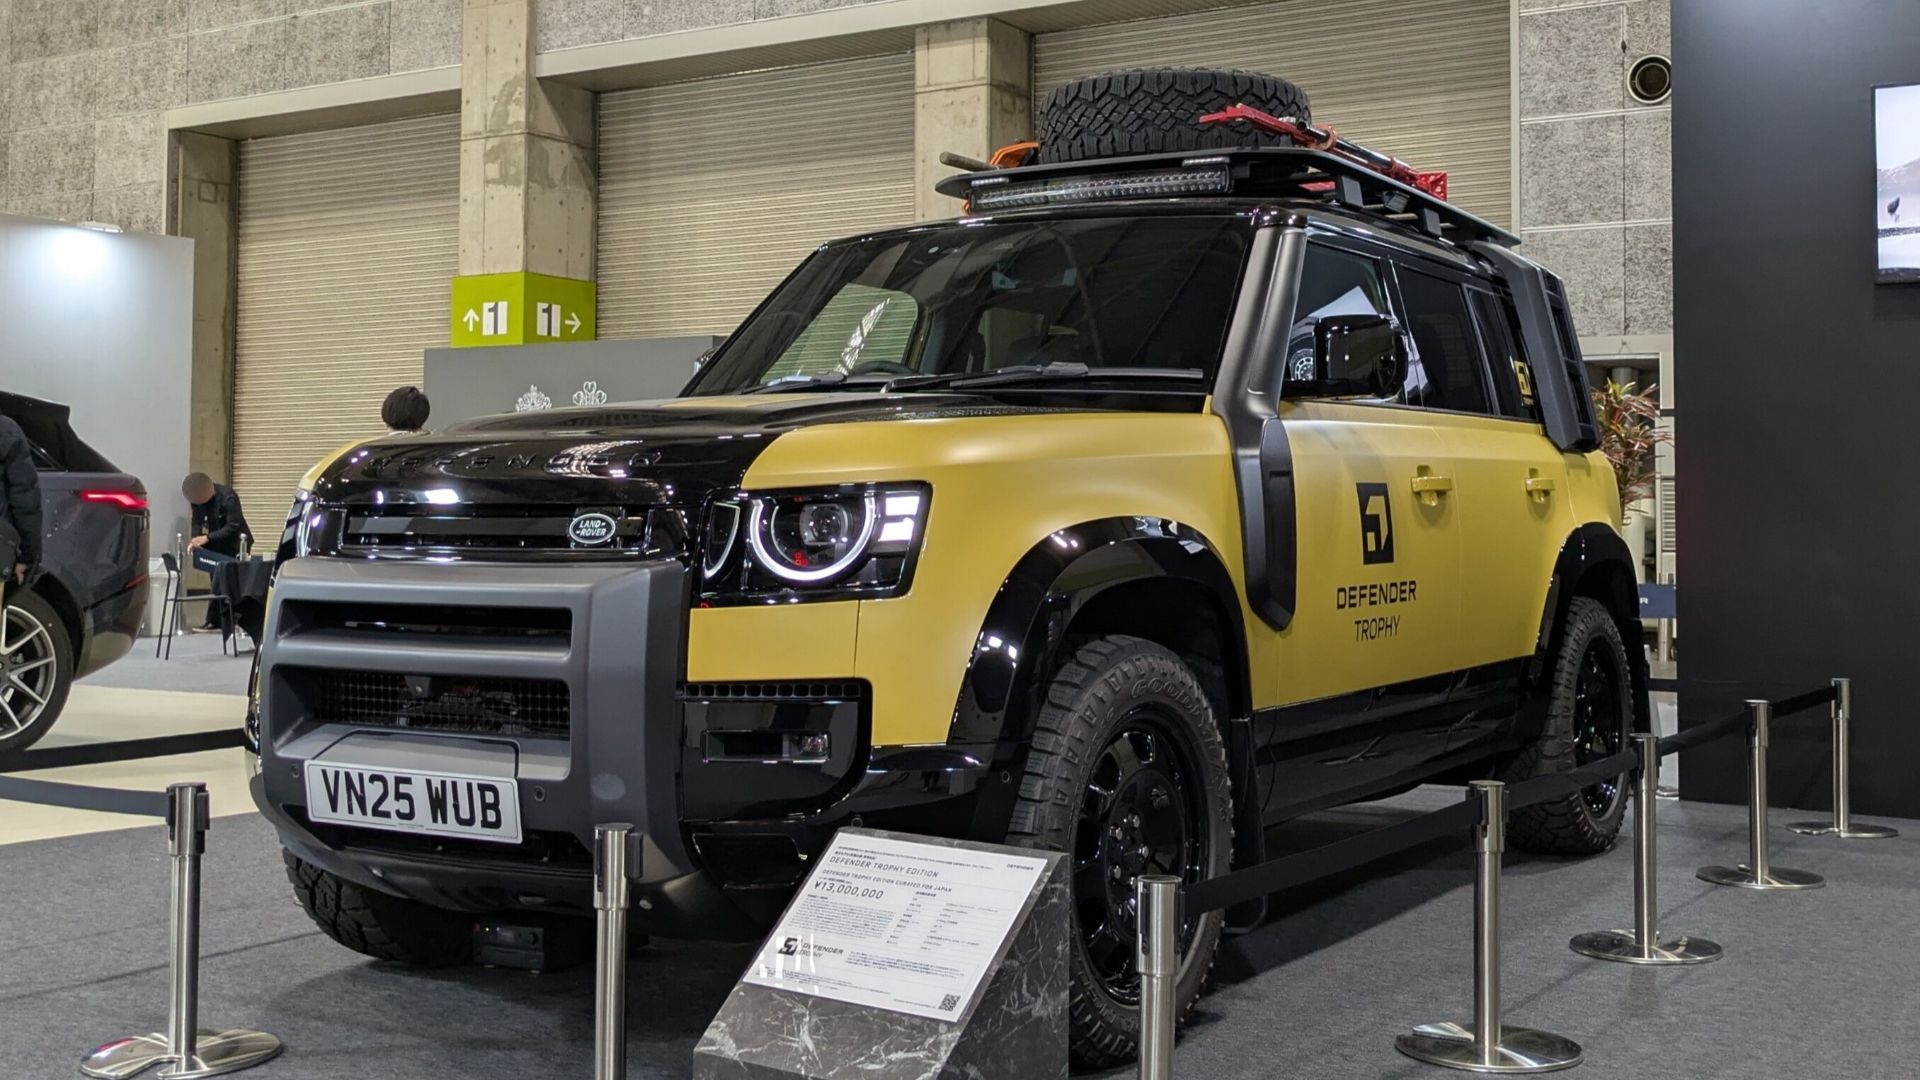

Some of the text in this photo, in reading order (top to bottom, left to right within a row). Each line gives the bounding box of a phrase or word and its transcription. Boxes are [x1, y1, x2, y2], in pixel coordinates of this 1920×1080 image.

[1337, 580, 1417, 609] DEFENDER
[1354, 615, 1401, 642] TROPHY
[321, 768, 502, 830] VN25 WUB
[830, 856, 871, 869] DEFENDER
[873, 862, 905, 873] TROPHY
[906, 867, 939, 878] EDITION
[814, 880, 884, 900] ¥13,000,000
[822, 869, 850, 878] DEFENDER
[851, 872, 871, 880] TROPHY
[873, 876, 894, 884] EDITION
[895, 880, 920, 888] CURATED
[933, 885, 952, 893] JAPAN
